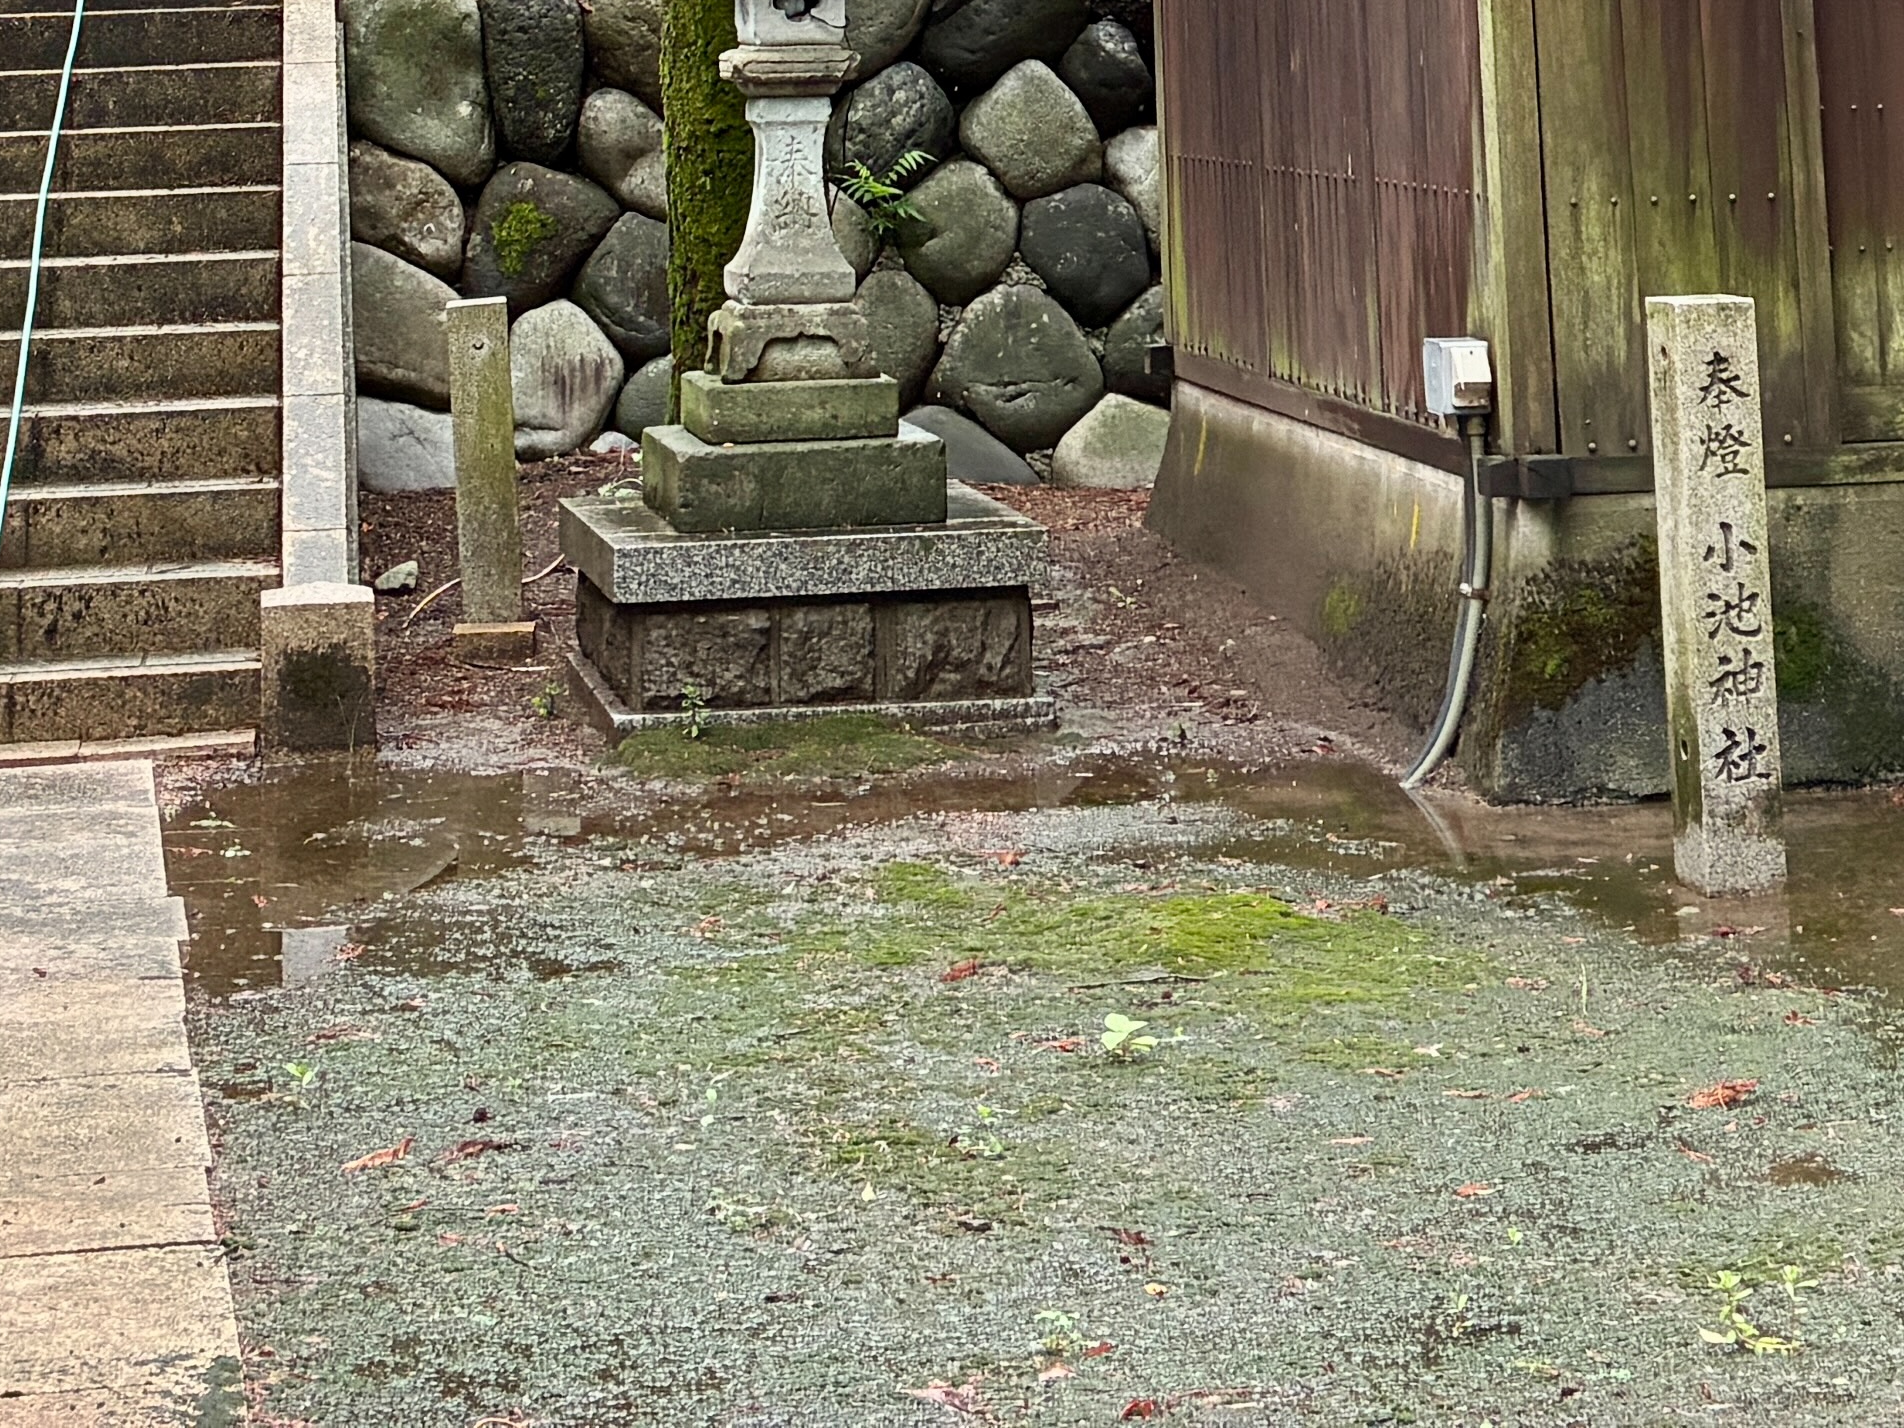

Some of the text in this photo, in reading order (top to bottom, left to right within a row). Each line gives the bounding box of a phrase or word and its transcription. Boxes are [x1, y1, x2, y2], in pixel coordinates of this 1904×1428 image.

[1698, 351, 1772, 784] 奉燈 小池神社
